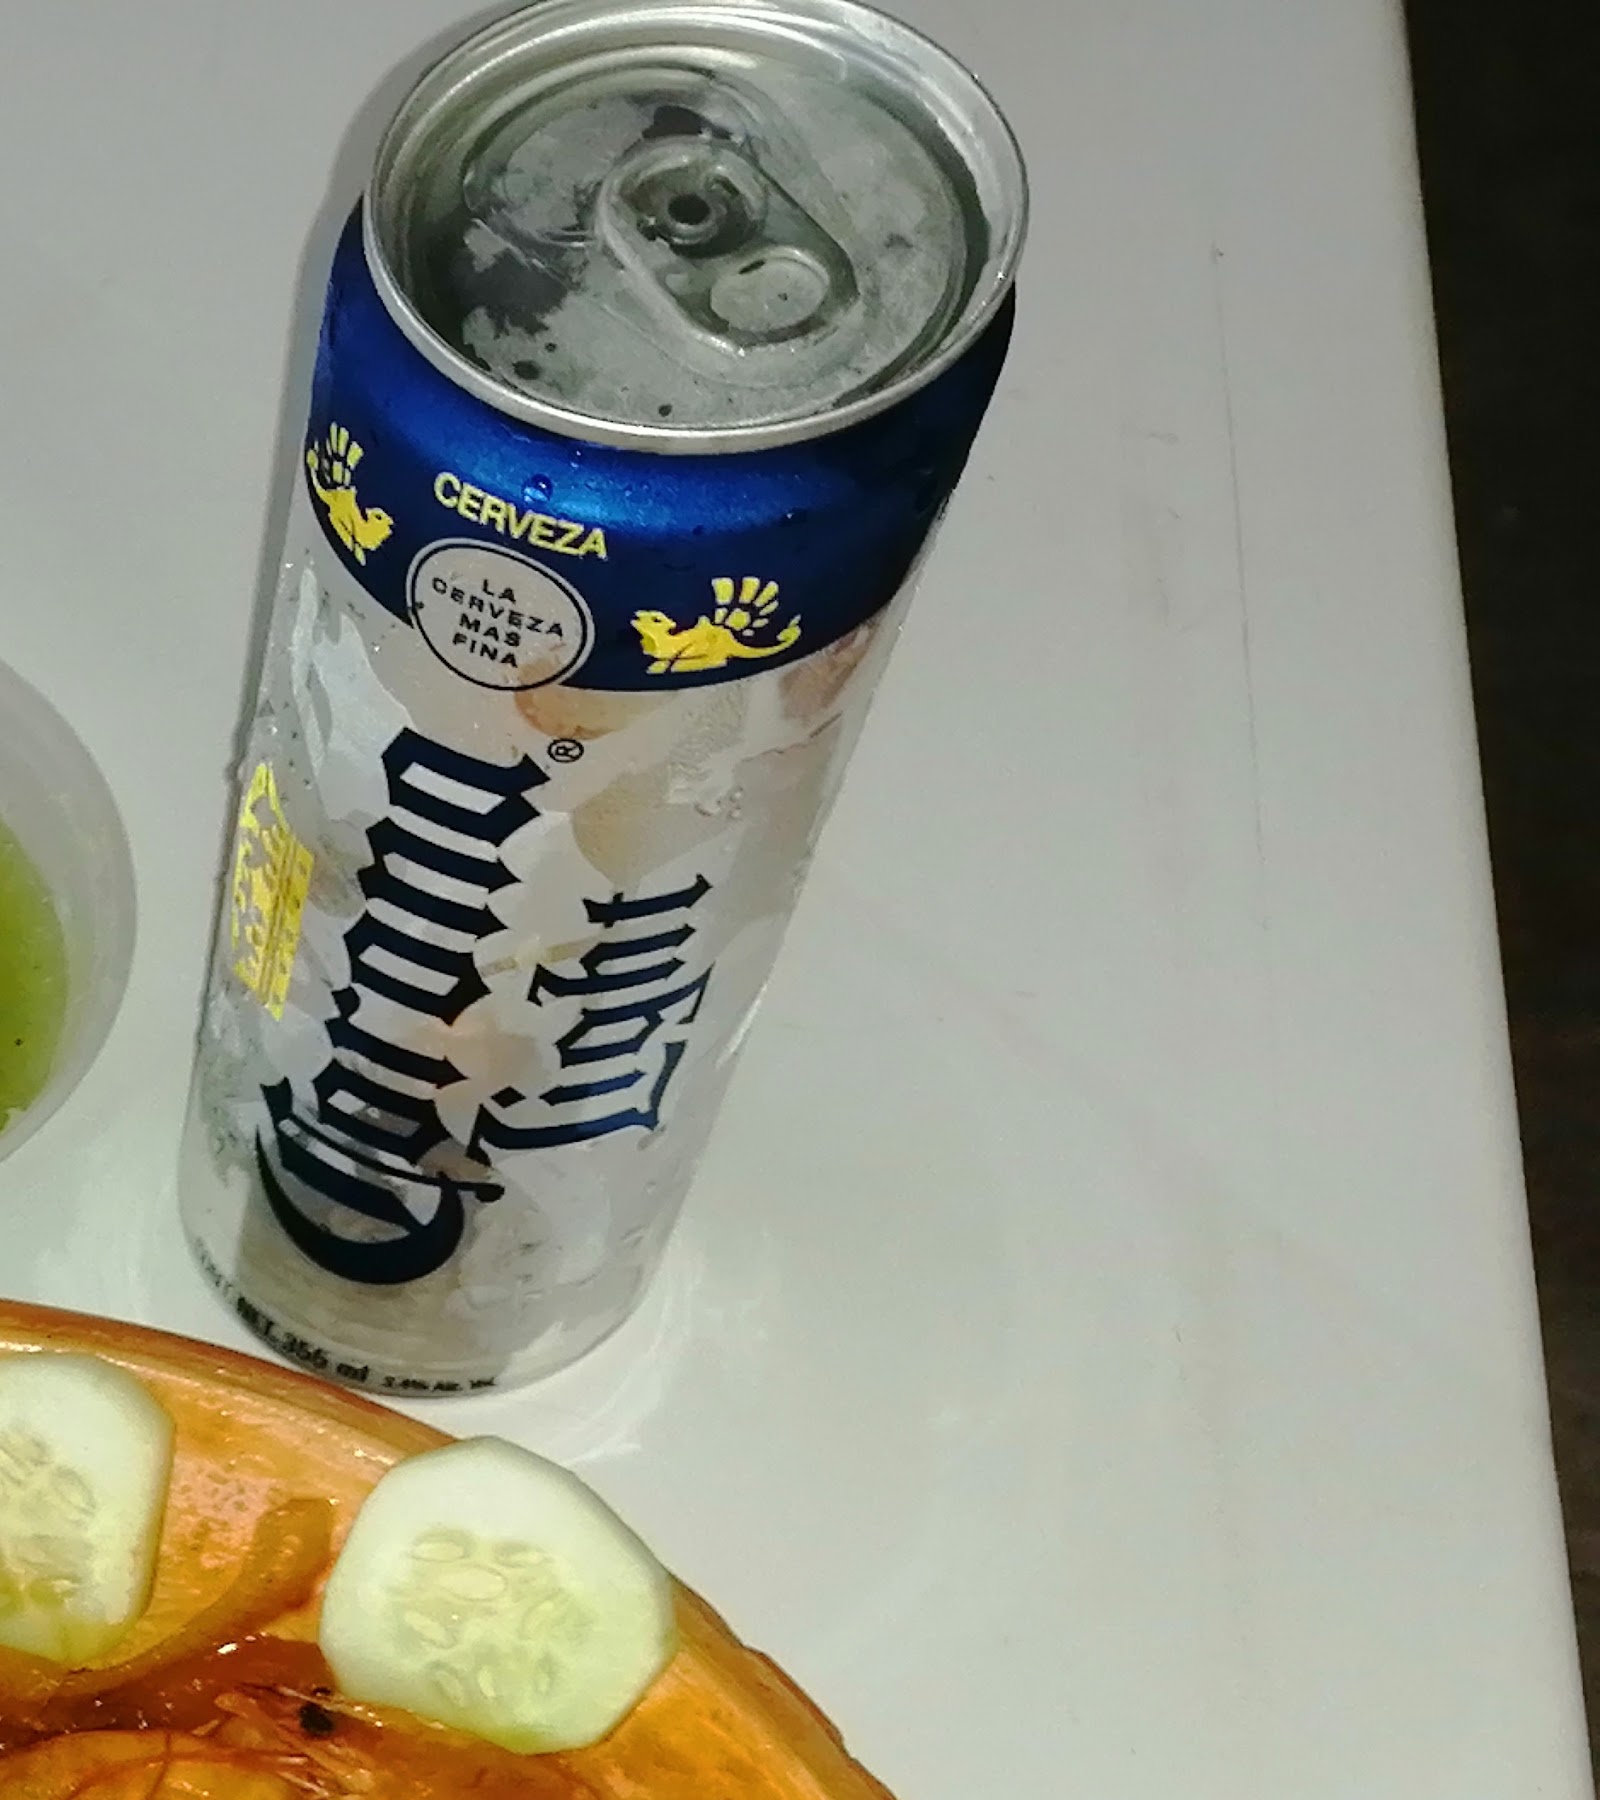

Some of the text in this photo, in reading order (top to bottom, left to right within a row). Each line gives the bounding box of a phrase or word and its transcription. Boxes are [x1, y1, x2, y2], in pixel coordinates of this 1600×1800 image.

[433, 471, 608, 560] CERVEZA
[431, 576, 564, 641] CERVEZA
[482, 578, 517, 605] LA
[452, 632, 518, 669] FINA
[459, 612, 521, 647] MAS
[256, 727, 550, 1286] Corona
[466, 873, 714, 1168] Light
